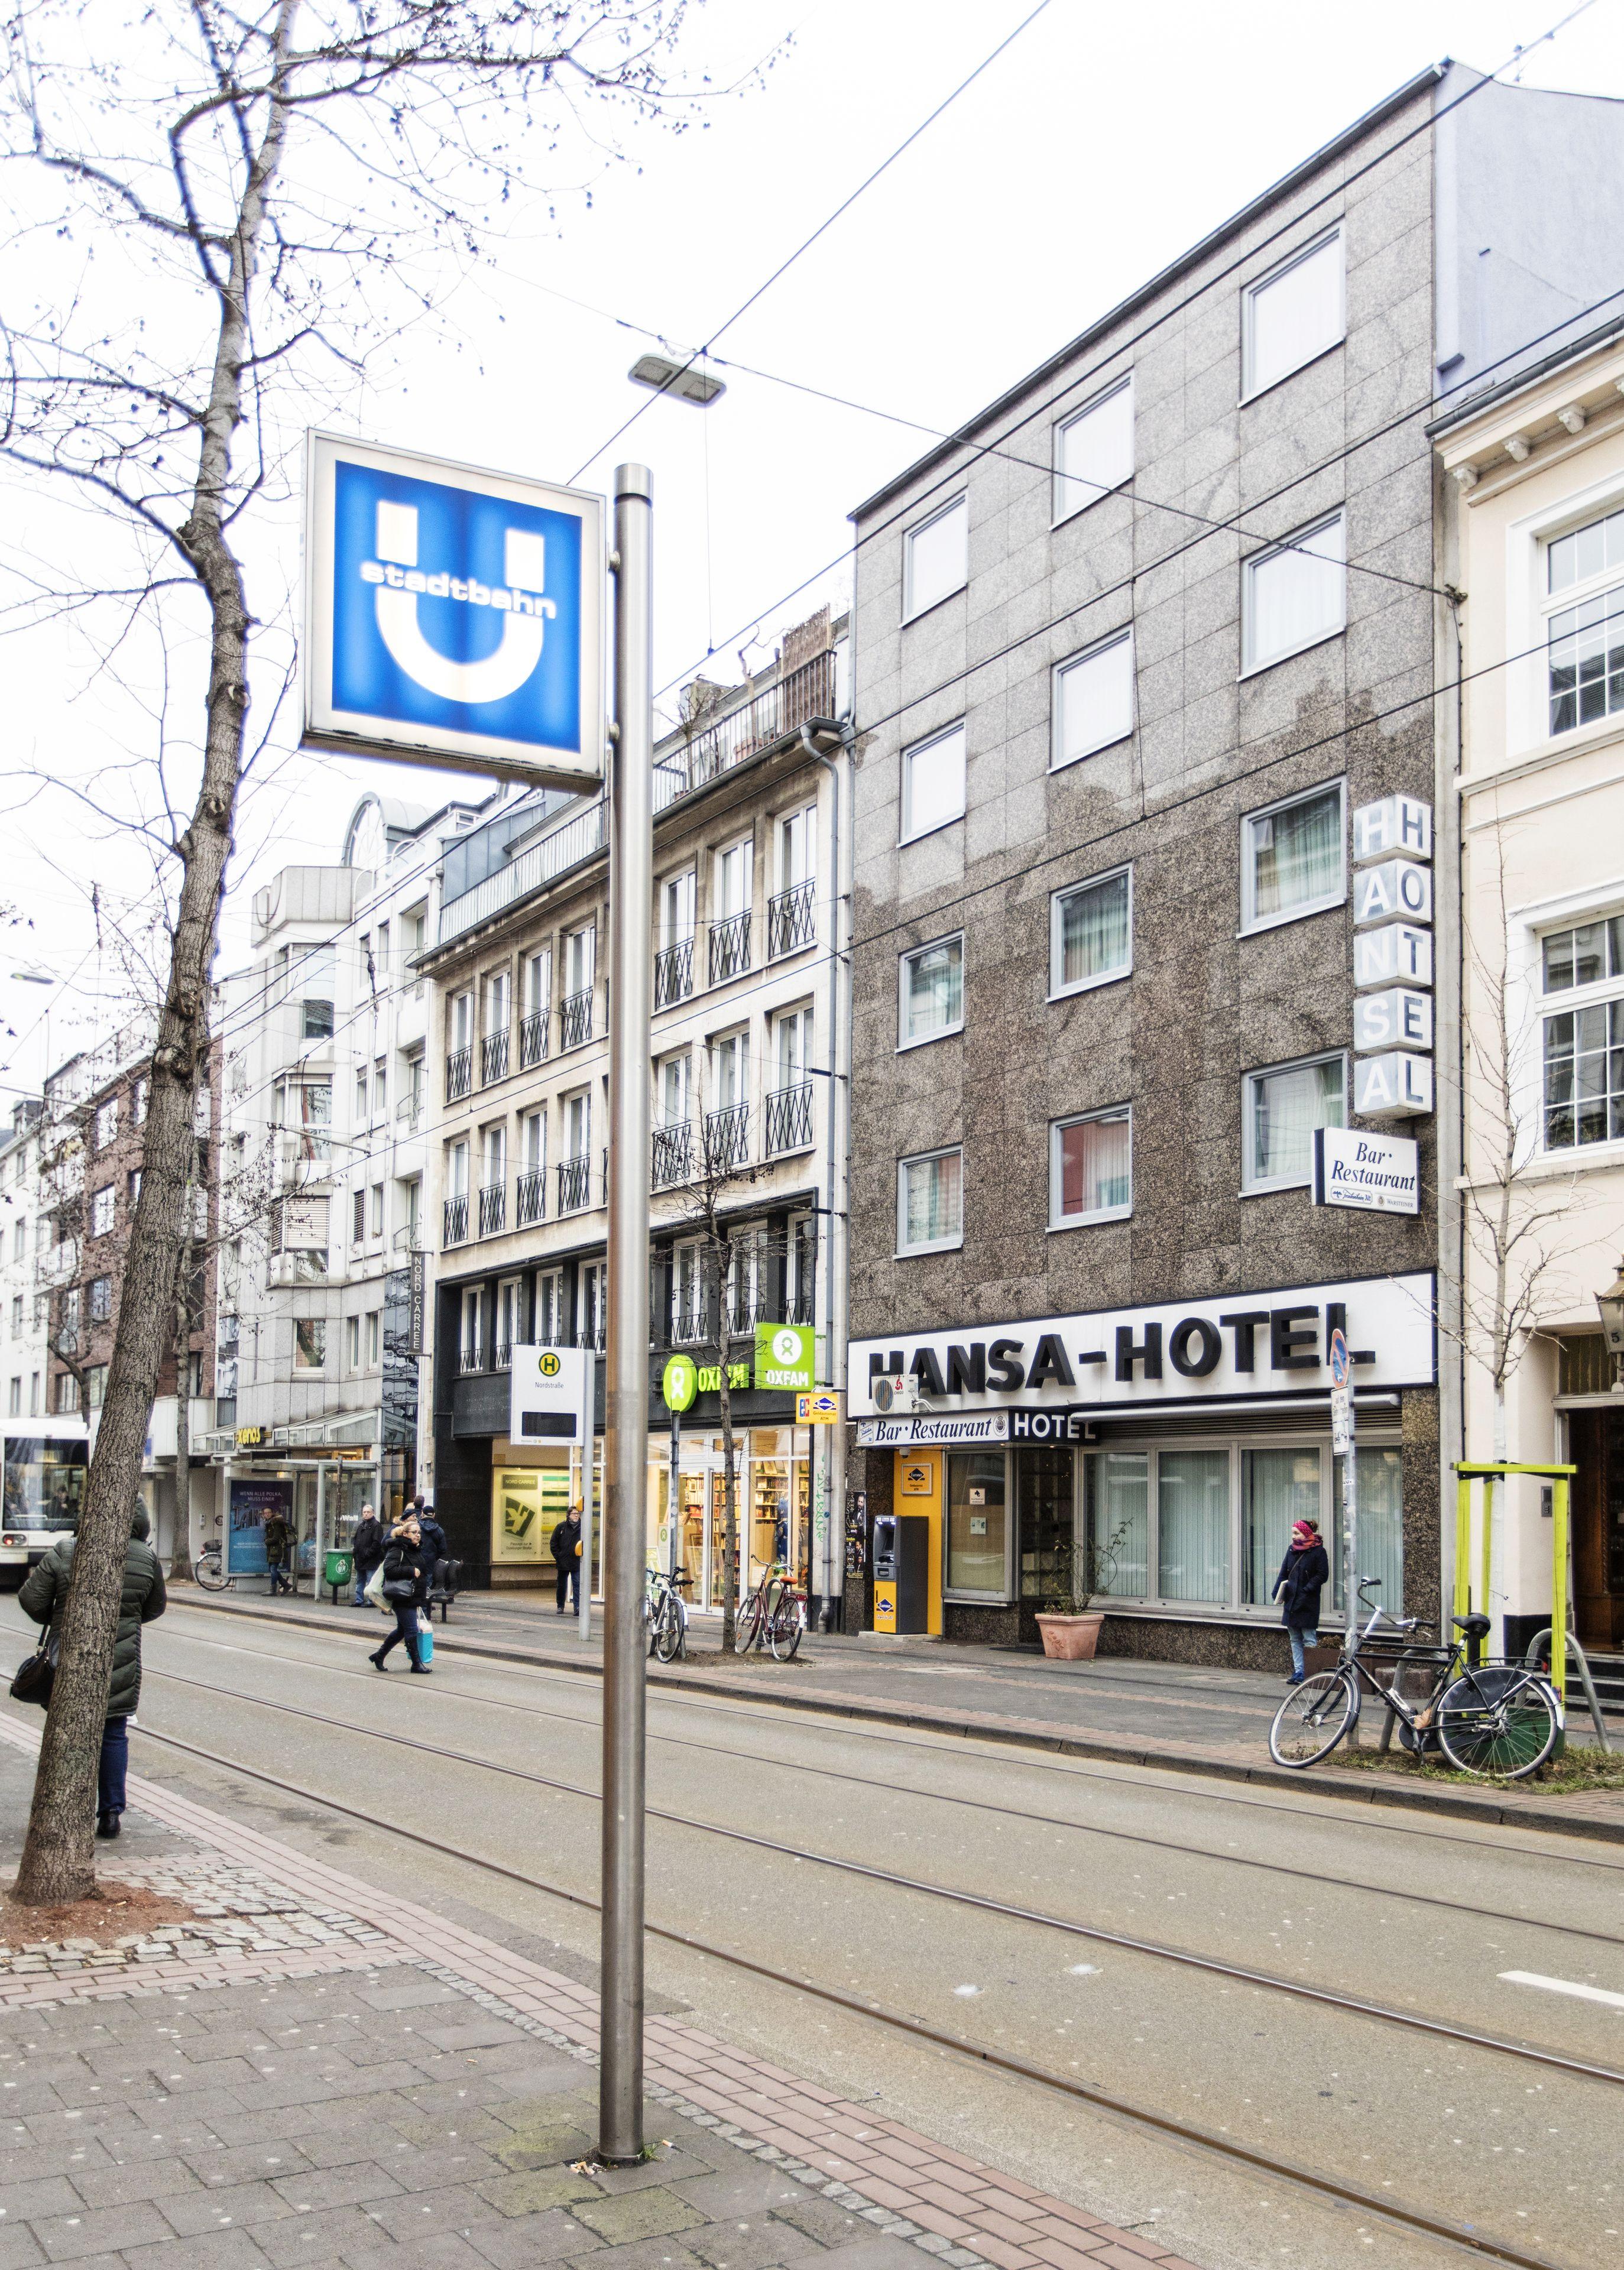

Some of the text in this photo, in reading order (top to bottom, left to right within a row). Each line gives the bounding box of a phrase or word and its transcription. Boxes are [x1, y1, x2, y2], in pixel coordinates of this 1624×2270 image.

[361, 561, 556, 619] stadtbahn
[1330, 1159, 1415, 1191] Restaurant
[413, 1296, 422, 1349] CARREE
[1611, 1332, 1620, 1343] 5
[766, 1370, 809, 1387] OXFAM
[1014, 1412, 1096, 1439] HOTEL
